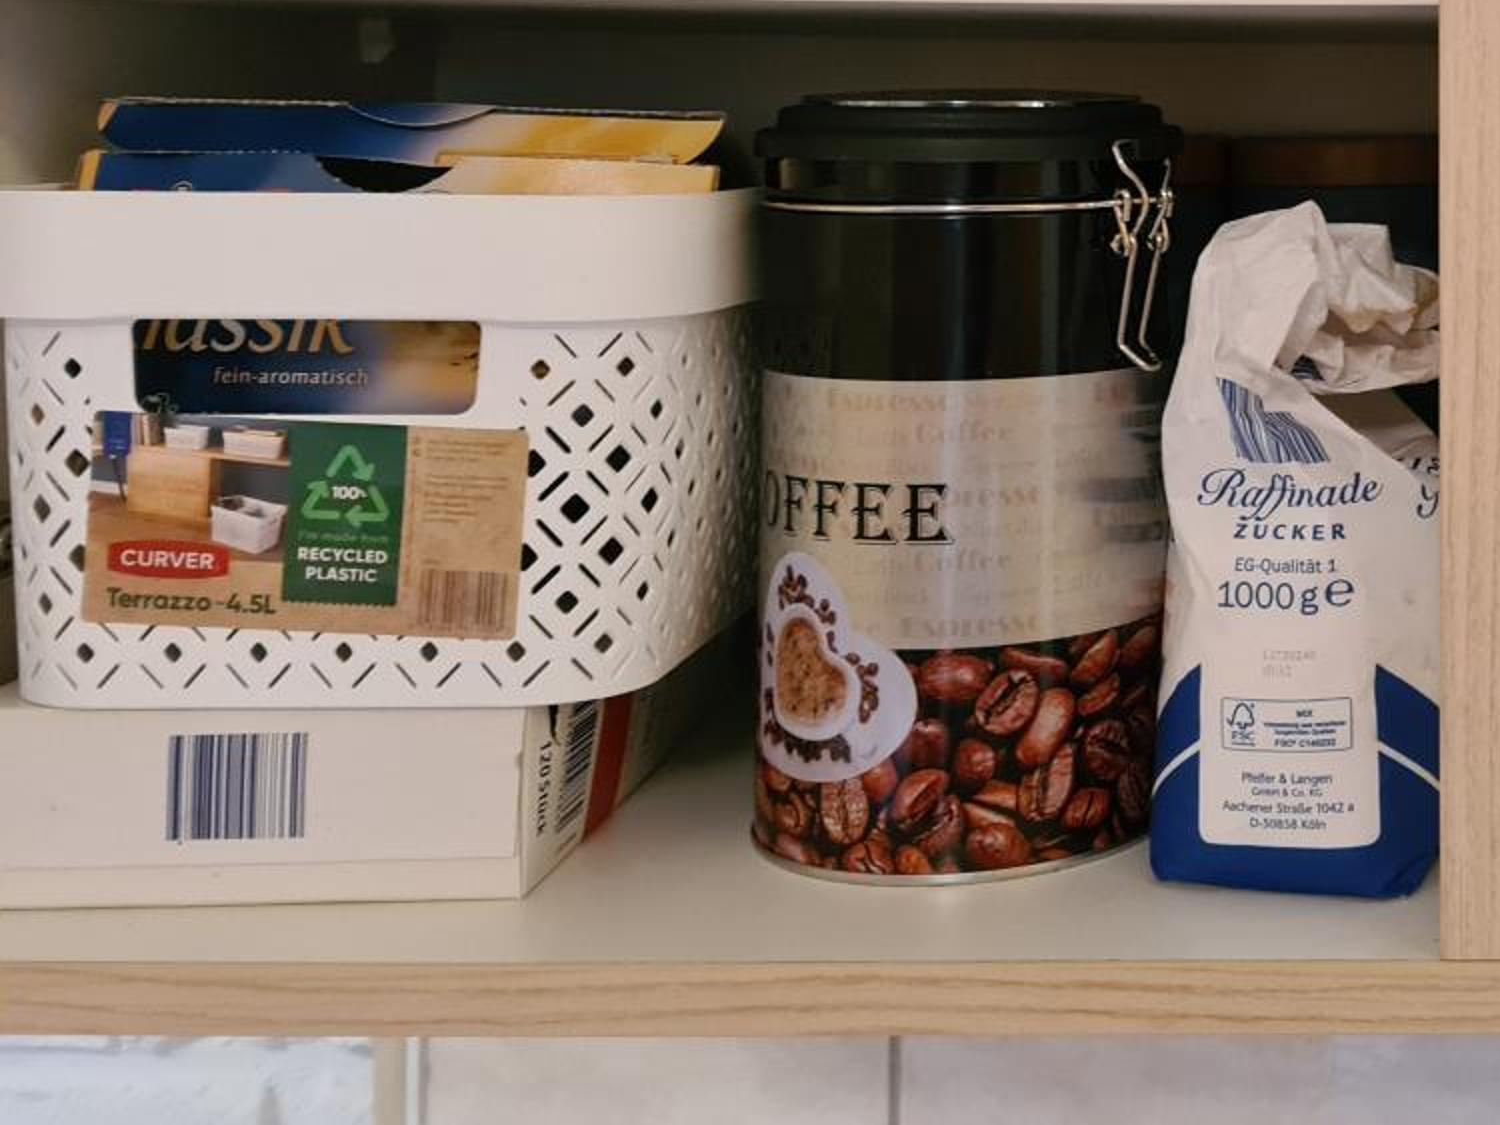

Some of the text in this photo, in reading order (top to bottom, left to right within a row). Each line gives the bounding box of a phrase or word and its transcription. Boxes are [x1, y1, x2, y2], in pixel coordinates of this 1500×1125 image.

[213, 366, 369, 387] fein-aromatisch
[1197, 468, 1383, 522] Raffinade
[1233, 523, 1347, 541] ZUCKER
[120, 549, 215, 569] CURVER
[297, 546, 388, 564] RECYCLED
[305, 566, 378, 582] PLASTIC
[1234, 556, 1321, 574] EG-Qualität
[1217, 581, 1295, 610] 1000
[1291, 774, 1332, 786] Langen
[1222, 801, 1273, 813] Aachener
[1276, 803, 1312, 814] Straße
[1301, 819, 1328, 830] Köln
